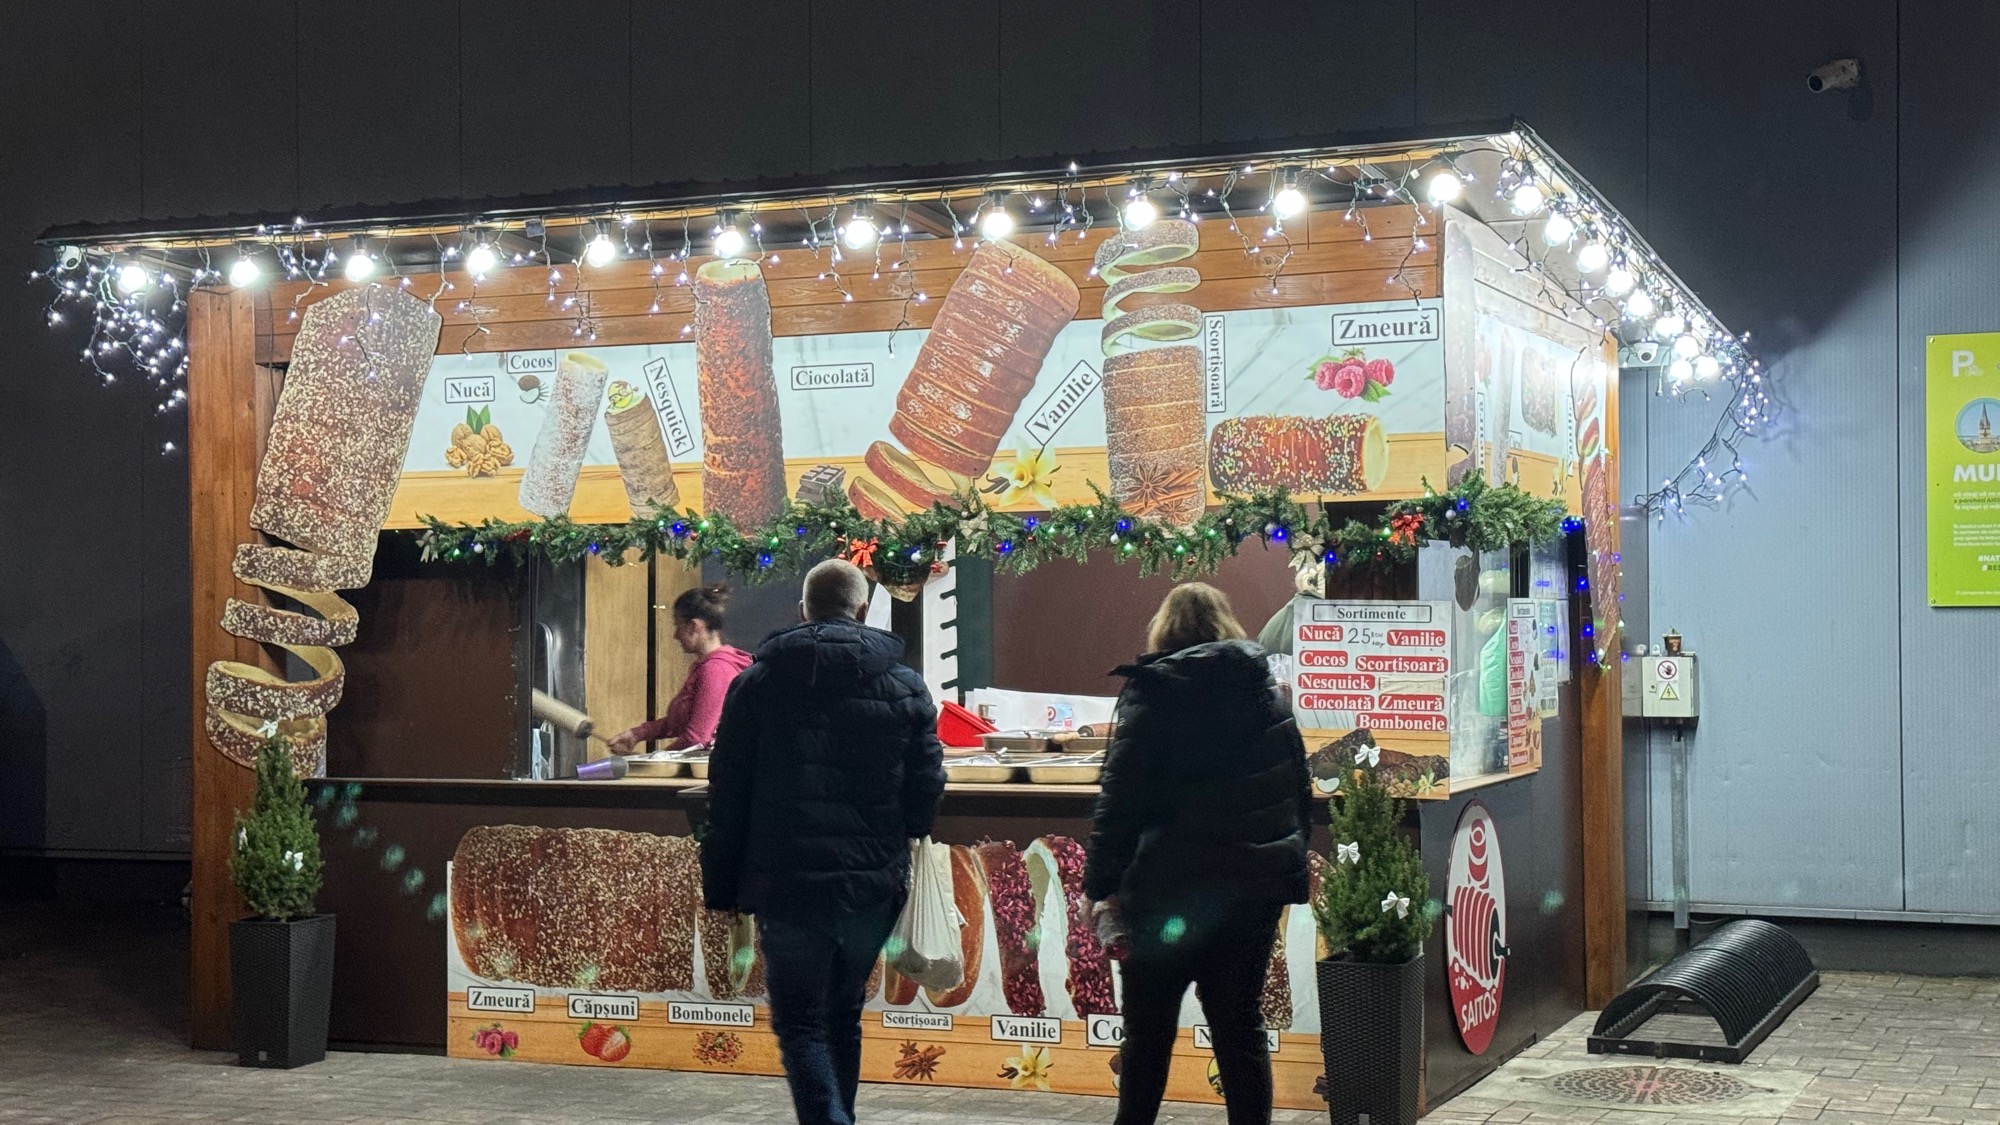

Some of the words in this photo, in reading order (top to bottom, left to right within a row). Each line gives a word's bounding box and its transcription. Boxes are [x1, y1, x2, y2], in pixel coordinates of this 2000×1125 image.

[1340, 314, 1432, 340] Zmeură
[510, 354, 553, 370] Cocos
[1207, 319, 1223, 408] Scorțișoară
[795, 367, 870, 387] Ciocolată
[450, 381, 490, 399] Nucă
[650, 364, 688, 450] Nesquick
[1032, 370, 1094, 434] Vanilie
[1337, 607, 1407, 620] Sortimente
[1301, 626, 1341, 640] Nucă
[1347, 627, 1371, 644] 25
[1389, 631, 1444, 646] Vanilie
[1301, 651, 1346, 666] Cocos
[1301, 674, 1371, 690] Nesquick
[1300, 694, 1372, 710] Ciocolată
[1381, 695, 1443, 711] Zmeură
[1359, 714, 1445, 730] Bombonele
[471, 990, 531, 1009] Zmeură
[571, 997, 636, 1019] Căpșuni
[671, 1004, 752, 1024] Bombonele
[1461, 988, 1498, 1034] SAITOS
[884, 1012, 949, 1028] Scorțișoară
[997, 1019, 1057, 1039] Vanilie
